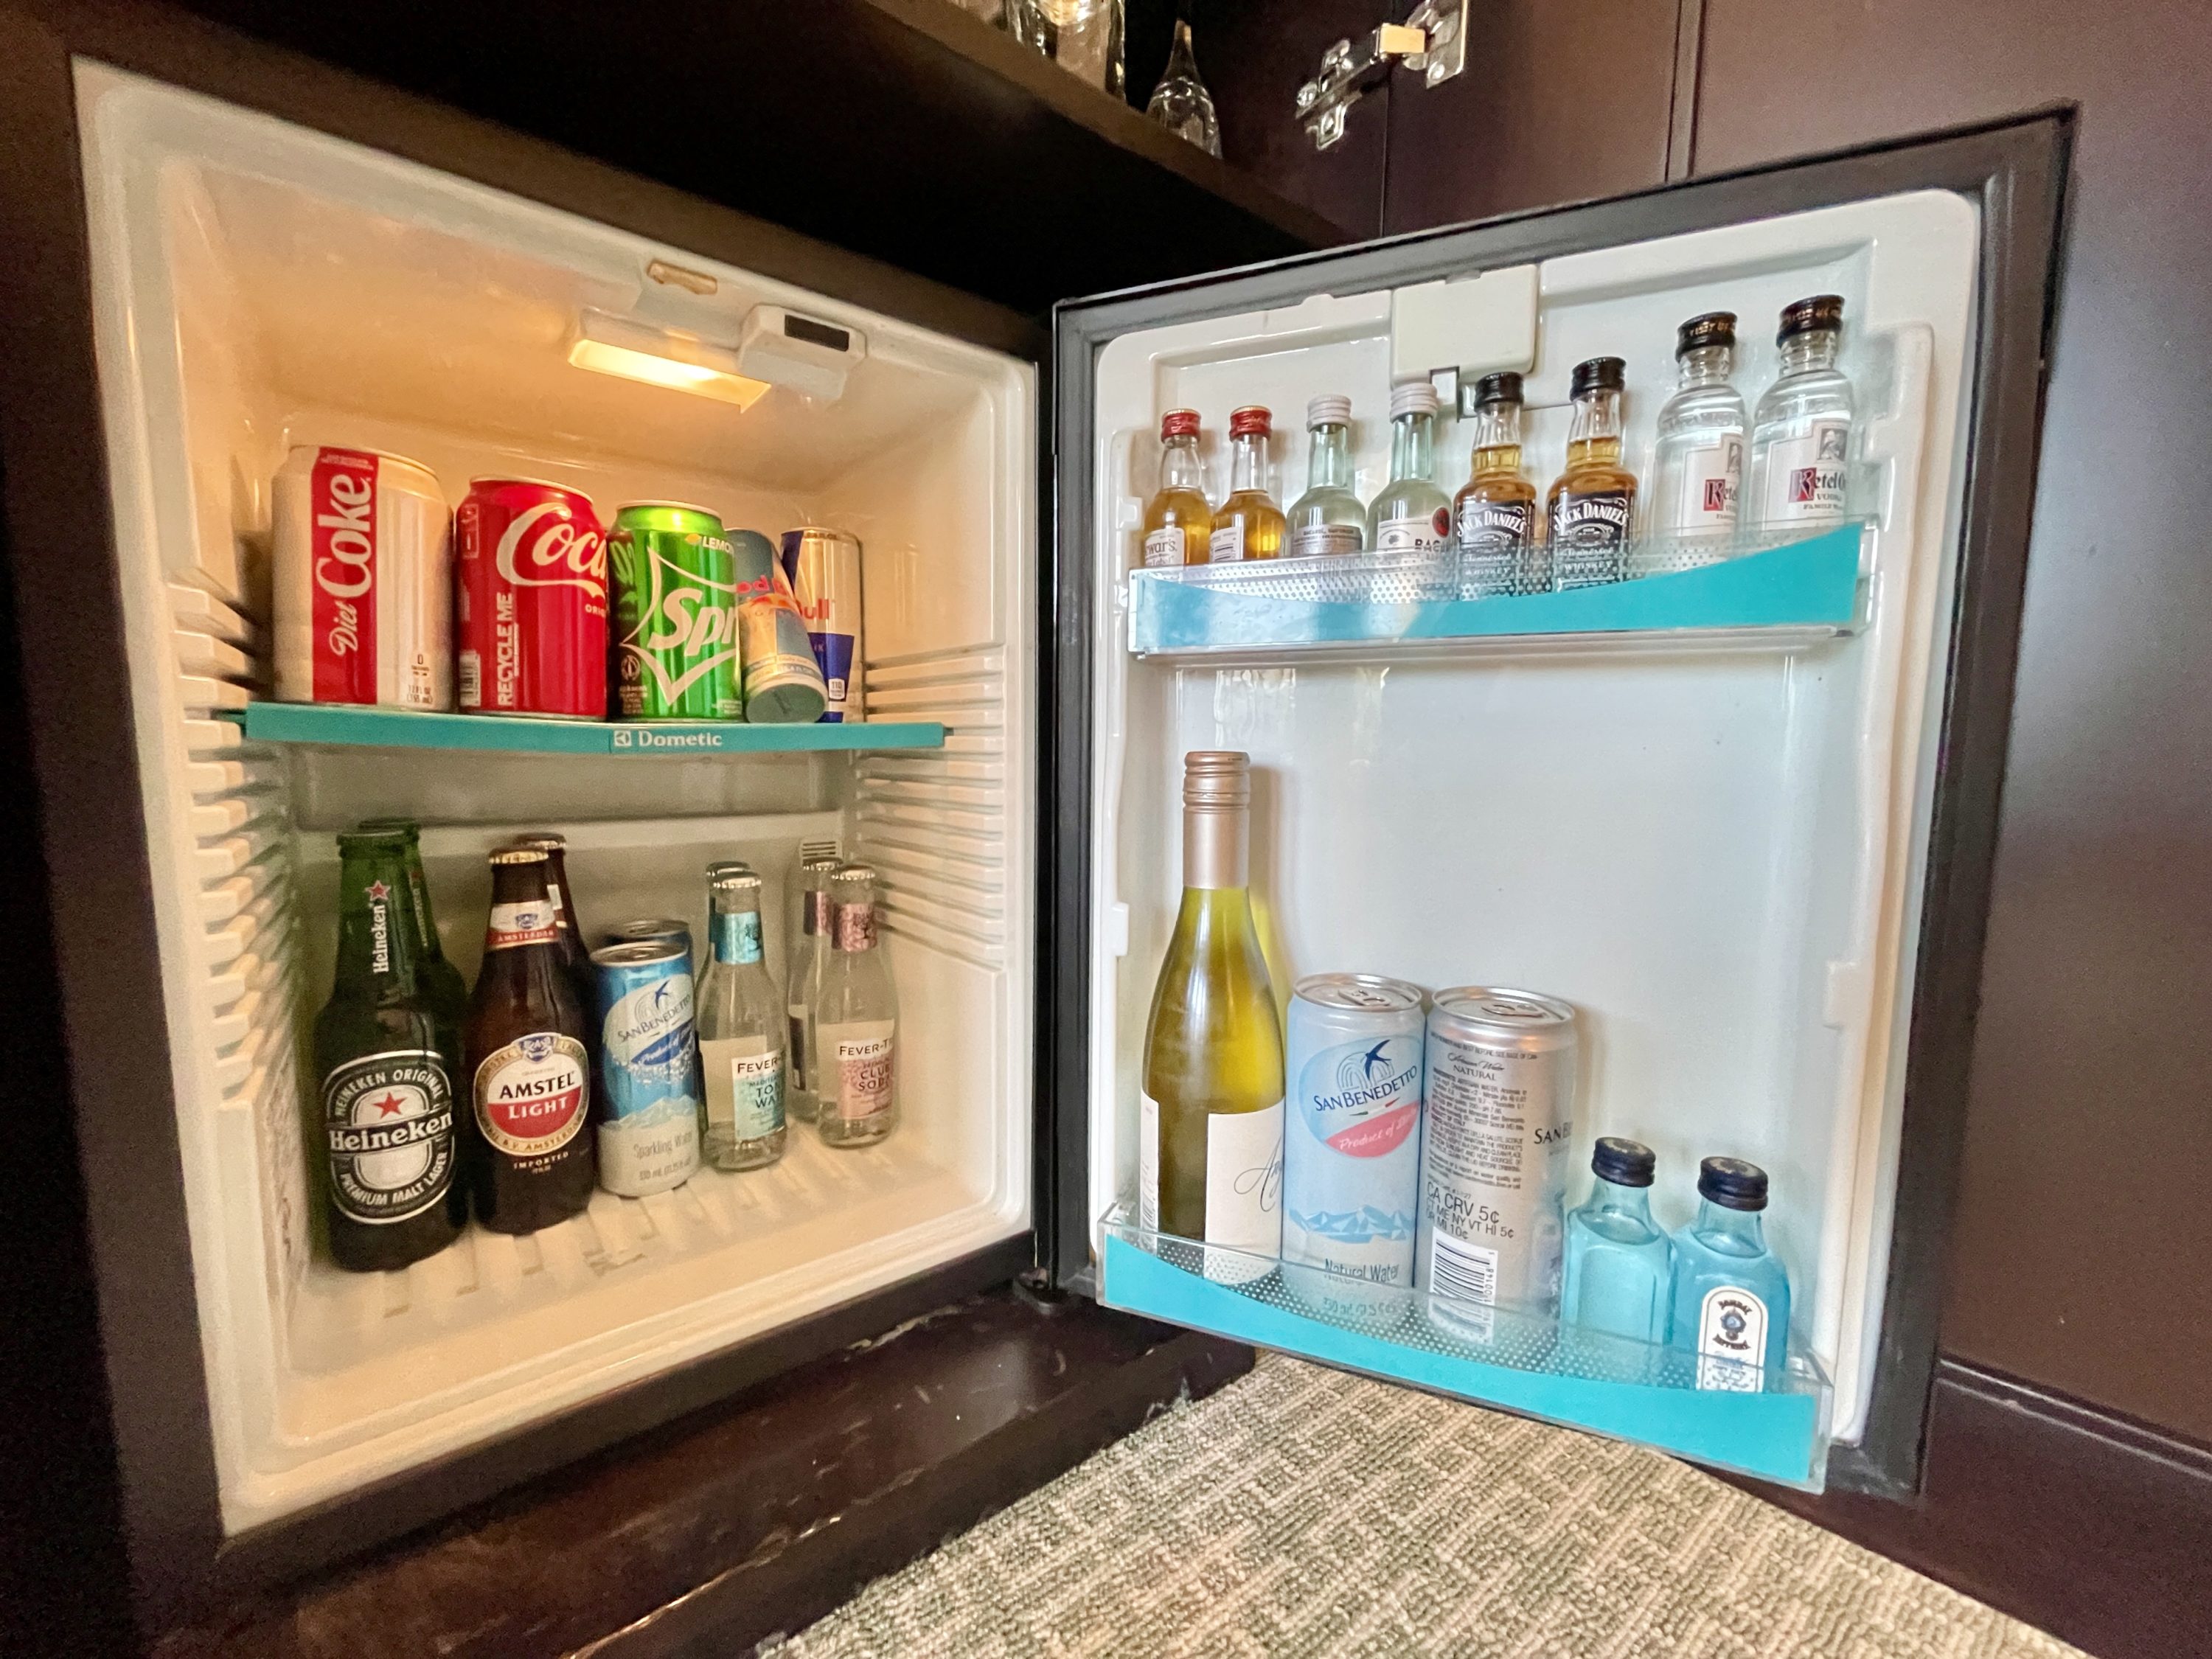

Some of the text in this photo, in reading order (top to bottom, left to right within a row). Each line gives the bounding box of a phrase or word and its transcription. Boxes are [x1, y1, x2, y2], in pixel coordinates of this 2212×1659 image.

[1457, 515, 1484, 537] JACK
[1553, 507, 1583, 531] JACK
[316, 474, 372, 599] Coke
[329, 600, 358, 656] Diet
[496, 591, 514, 706] RECYCLE ME
[638, 730, 723, 746] Dometic
[370, 904, 389, 973] Heineken
[499, 1073, 575, 1099] AMSTEL
[1453, 1064, 1497, 1082] NATURAL
[335, 1068, 444, 1116] HEINEKEN ORIGINAL
[508, 1096, 568, 1119] LIGHT
[328, 1112, 453, 1152] Heineken
[340, 1172, 388, 1206] PREMIUM
[392, 1183, 425, 1204] MALT
[1426, 1180, 1441, 1203] CA
[1444, 1192, 1474, 1217] CRV
[1478, 1206, 1500, 1224] 5¢
[1469, 1218, 1482, 1232] VT
